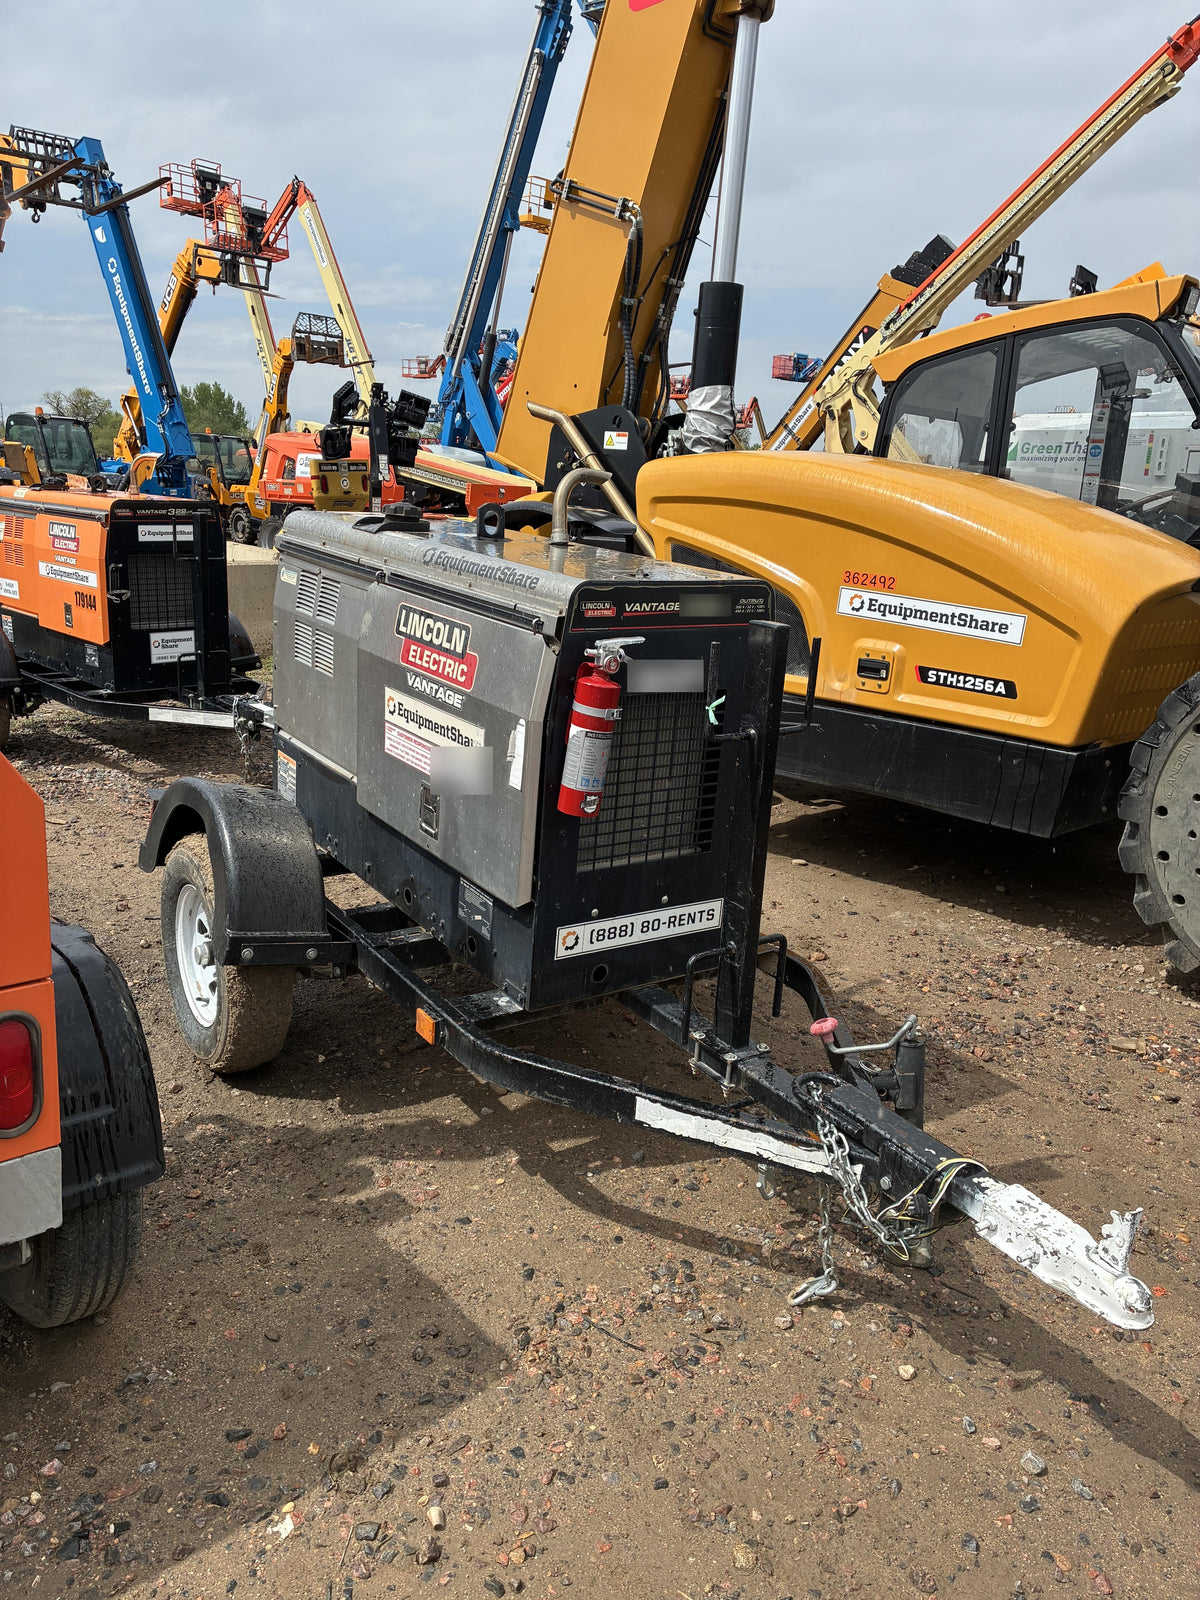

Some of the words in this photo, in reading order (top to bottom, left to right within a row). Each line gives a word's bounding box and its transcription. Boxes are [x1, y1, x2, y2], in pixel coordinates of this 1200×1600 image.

[161, 275, 178, 311] JCB
[112, 273, 151, 395] EquipmentShare
[345, 337, 355, 354] JLG
[261, 356, 270, 374] LIFT
[267, 373, 277, 403] JCB
[1020, 441, 1088, 455] GreenTha
[1019, 455, 1059, 463] maximizing
[50, 523, 75, 538] LINCOLN
[54, 538, 77, 551] ELECTRIC
[54, 554, 77, 565] VANTAGE
[50, 566, 89, 583] EquipmentShare
[435, 550, 540, 591] EquipmentShare
[843, 570, 896, 590] 362492
[75, 590, 97, 611] 179144
[582, 602, 611, 610] LINCOLN
[624, 602, 680, 612] VANTAGE
[867, 597, 1009, 635] EquipmentShare
[398, 609, 466, 654] LINCOLN
[408, 645, 468, 683] ELECTRIC
[406, 671, 464, 710] VANTAGE
[927, 670, 1006, 695] STH1256A
[397, 701, 473, 748] EquipmentSha
[589, 922, 635, 945] (888)
[640, 908, 716, 934] 80-RENTS
